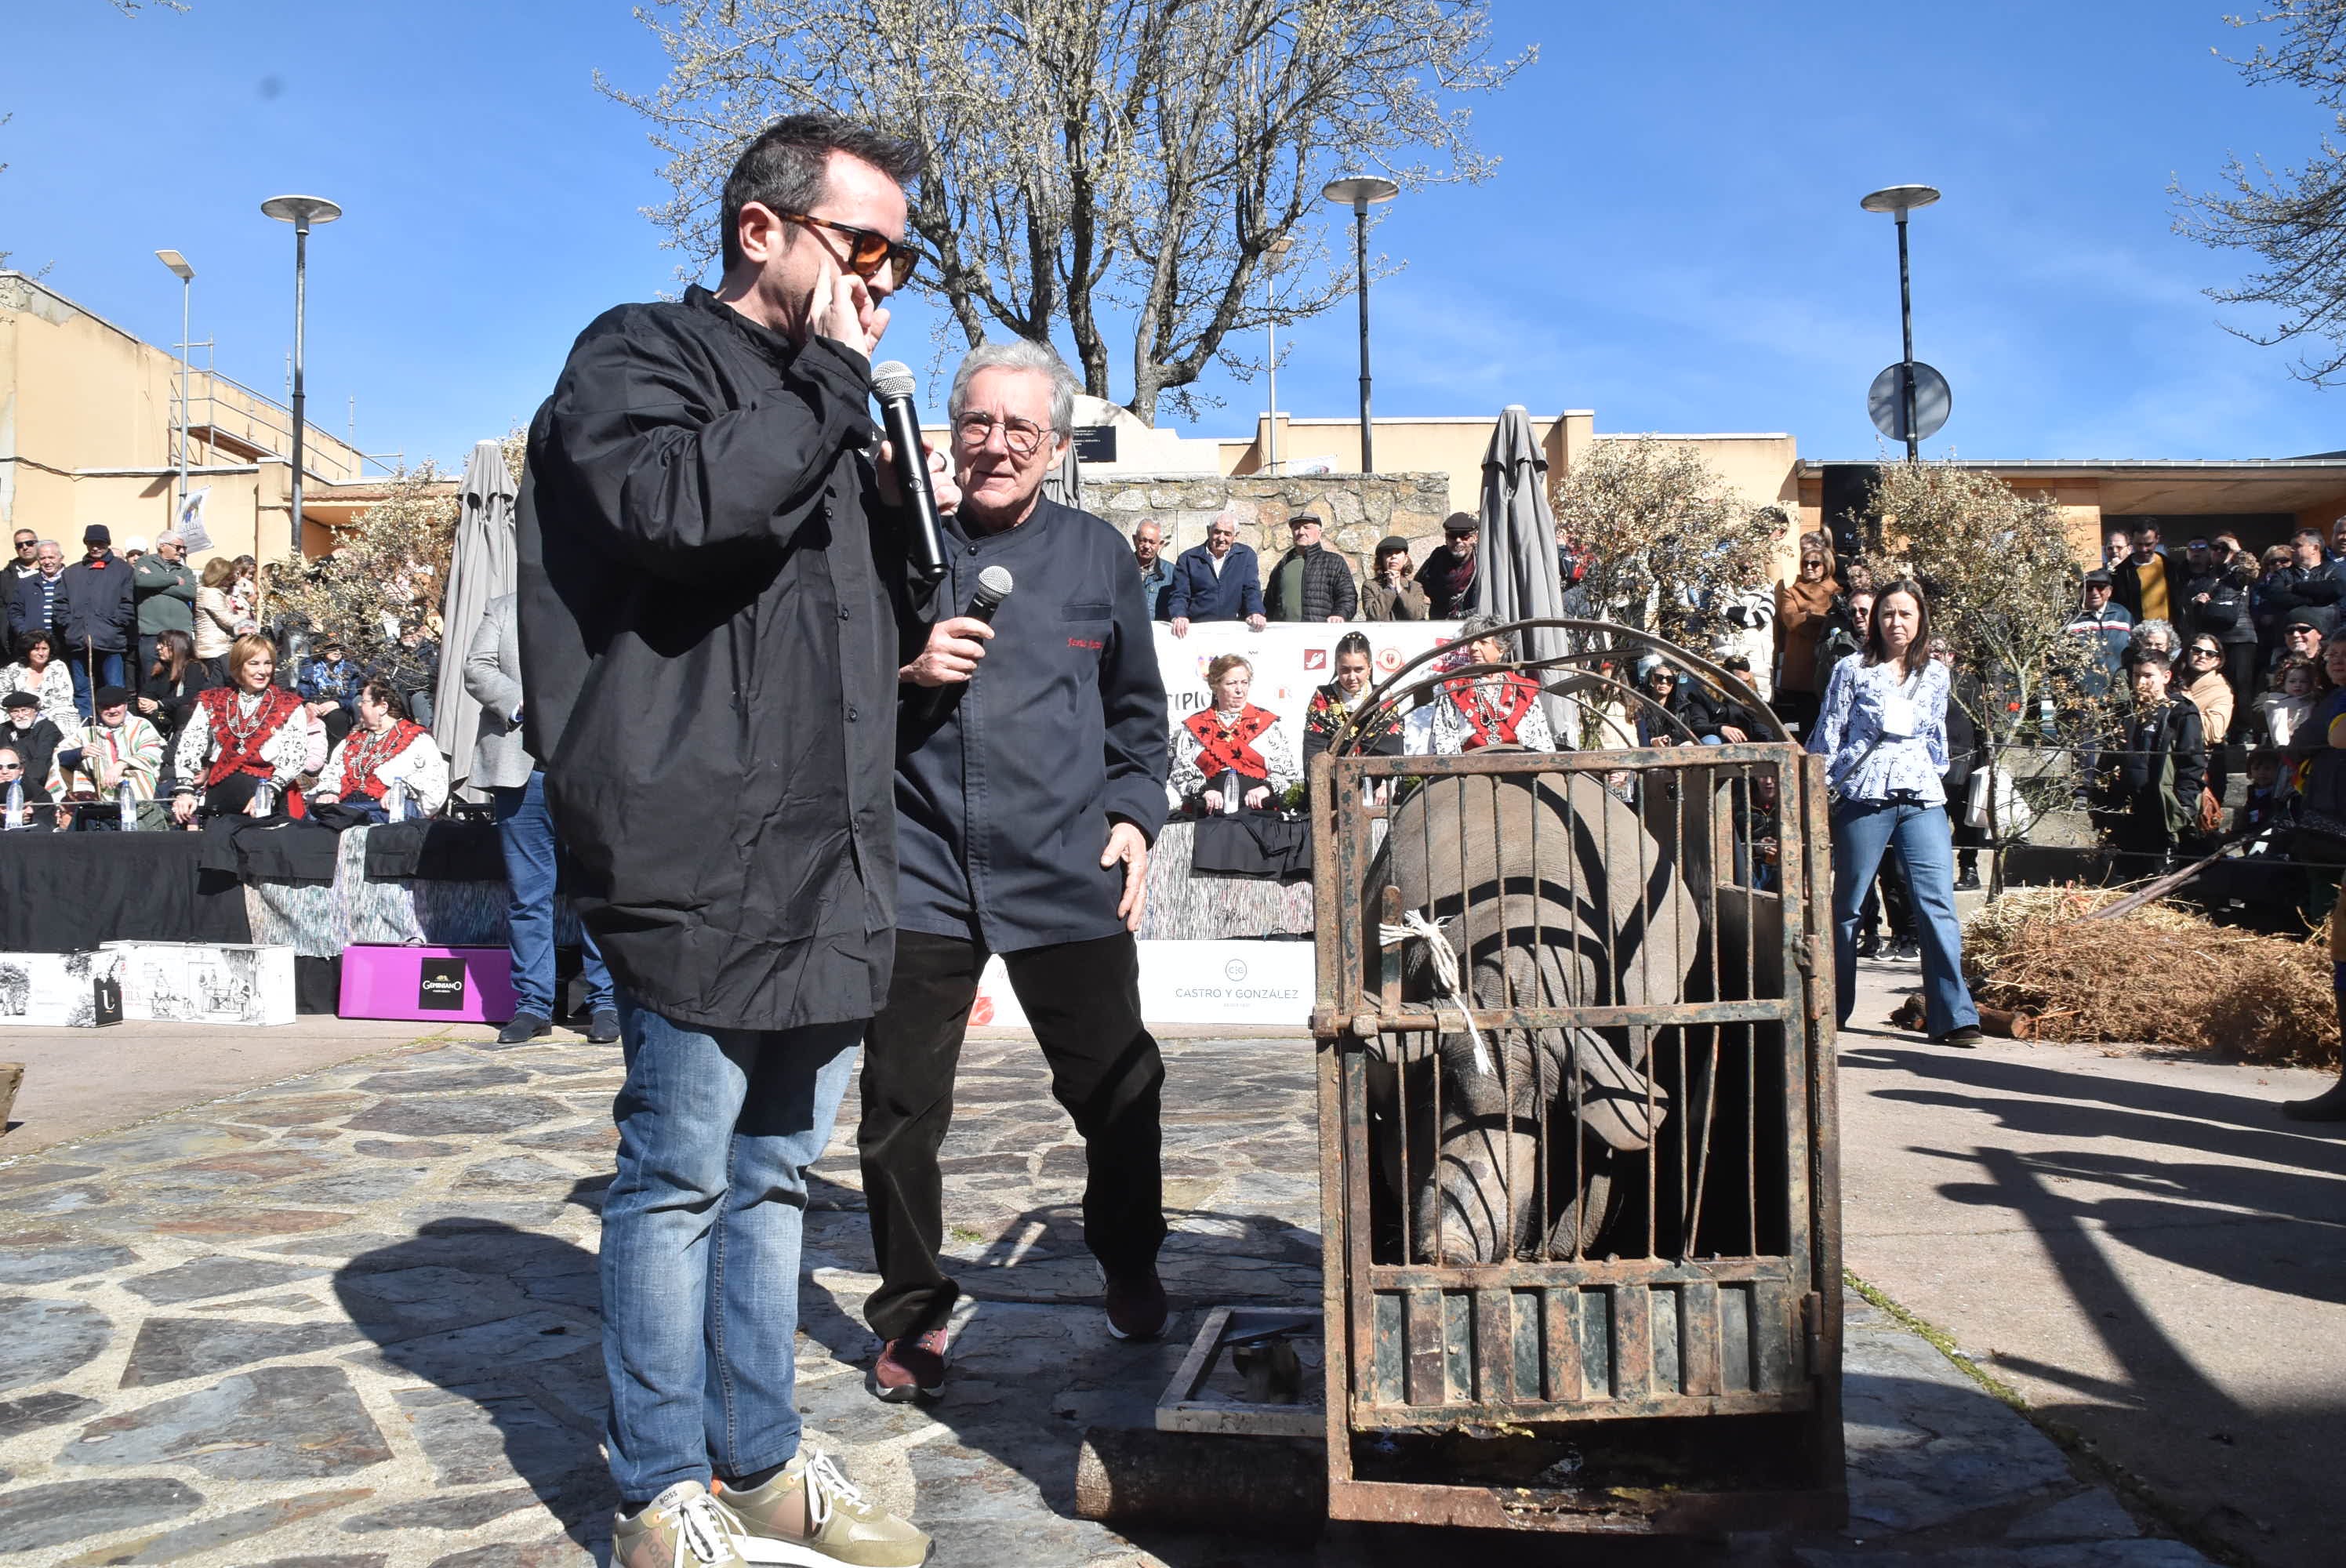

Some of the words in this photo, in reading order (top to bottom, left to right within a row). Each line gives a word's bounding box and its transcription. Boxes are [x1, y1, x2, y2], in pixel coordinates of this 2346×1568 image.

[422, 980, 463, 991] GEMINIANO
[1175, 989, 1222, 998] CASTRO
[1225, 989, 1233, 998] Y
[1235, 988, 1299, 999] GONZÁLEZ
[659, 1490, 678, 1505] BOSS
